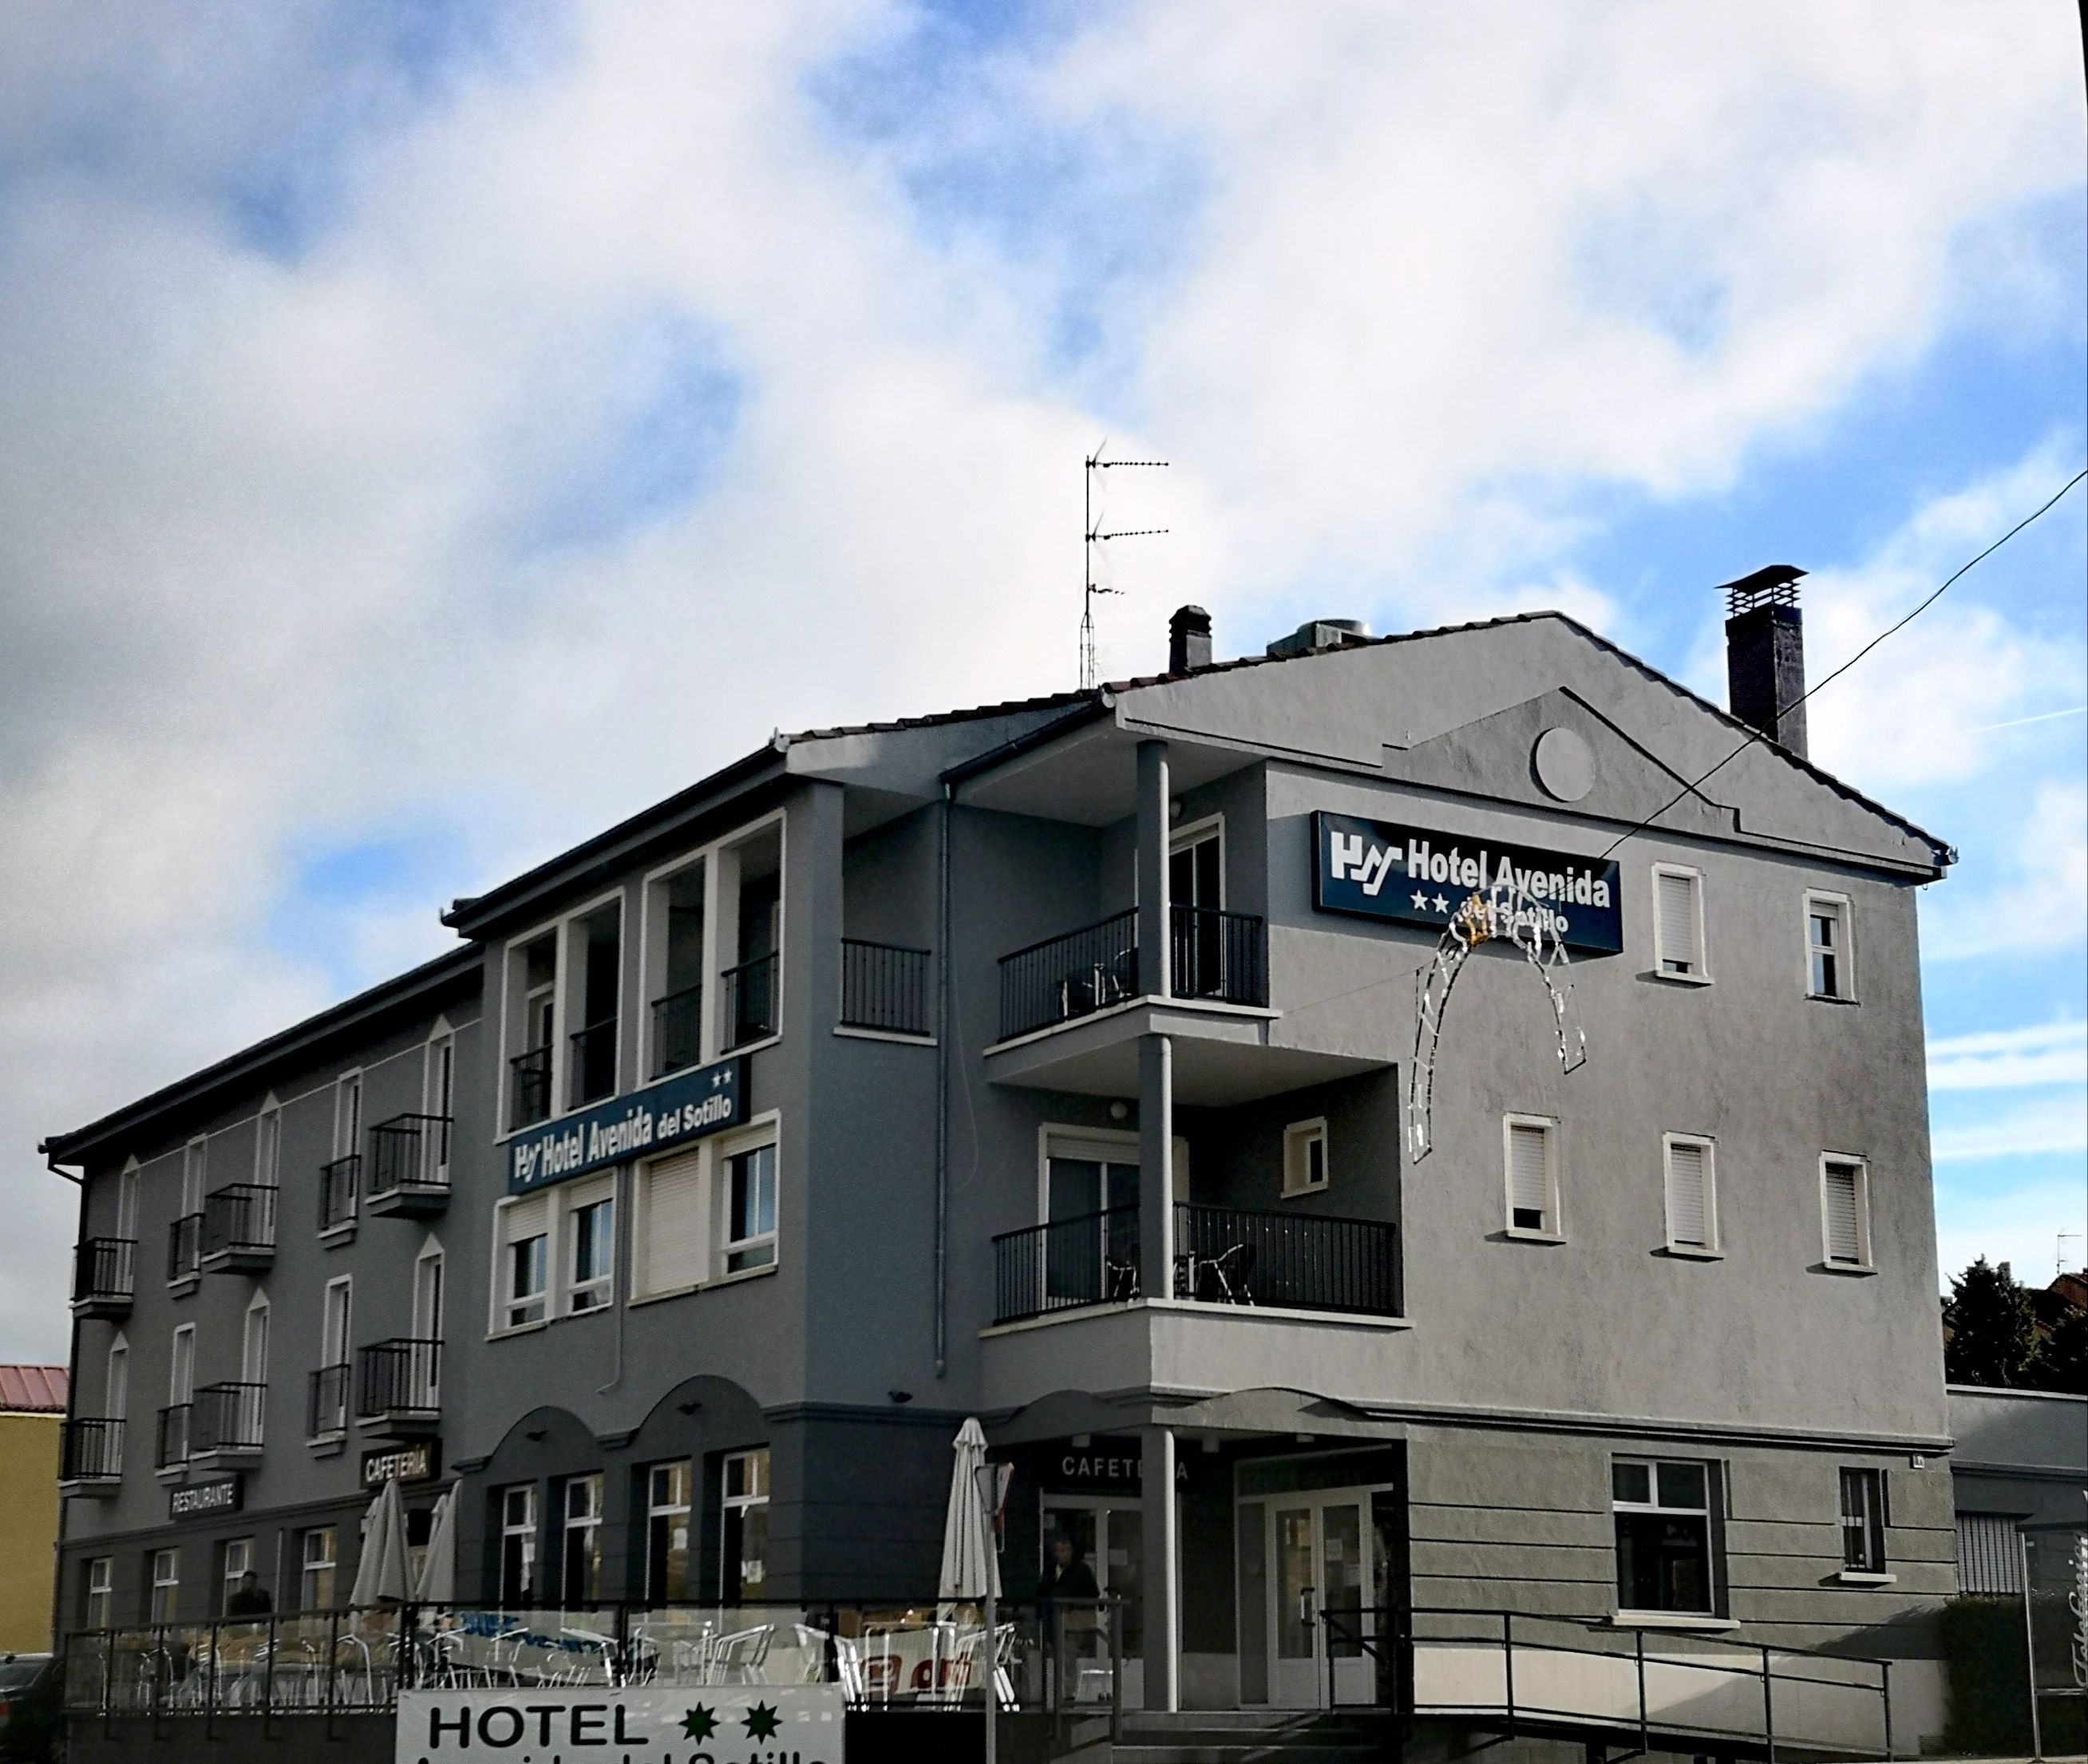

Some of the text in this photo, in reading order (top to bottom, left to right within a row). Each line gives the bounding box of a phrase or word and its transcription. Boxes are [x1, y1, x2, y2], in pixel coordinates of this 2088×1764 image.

[1407, 838, 1611, 908] Hotel Avenida
[541, 1123, 583, 1178] Hotel
[587, 1105, 653, 1163] Avenida
[657, 1109, 681, 1140] del
[683, 1094, 732, 1131] Sotillo
[1062, 1455, 1188, 1481] CAFETA
[171, 1483, 233, 1513] RESTAURANTE
[429, 1704, 649, 1749] HOTEL
